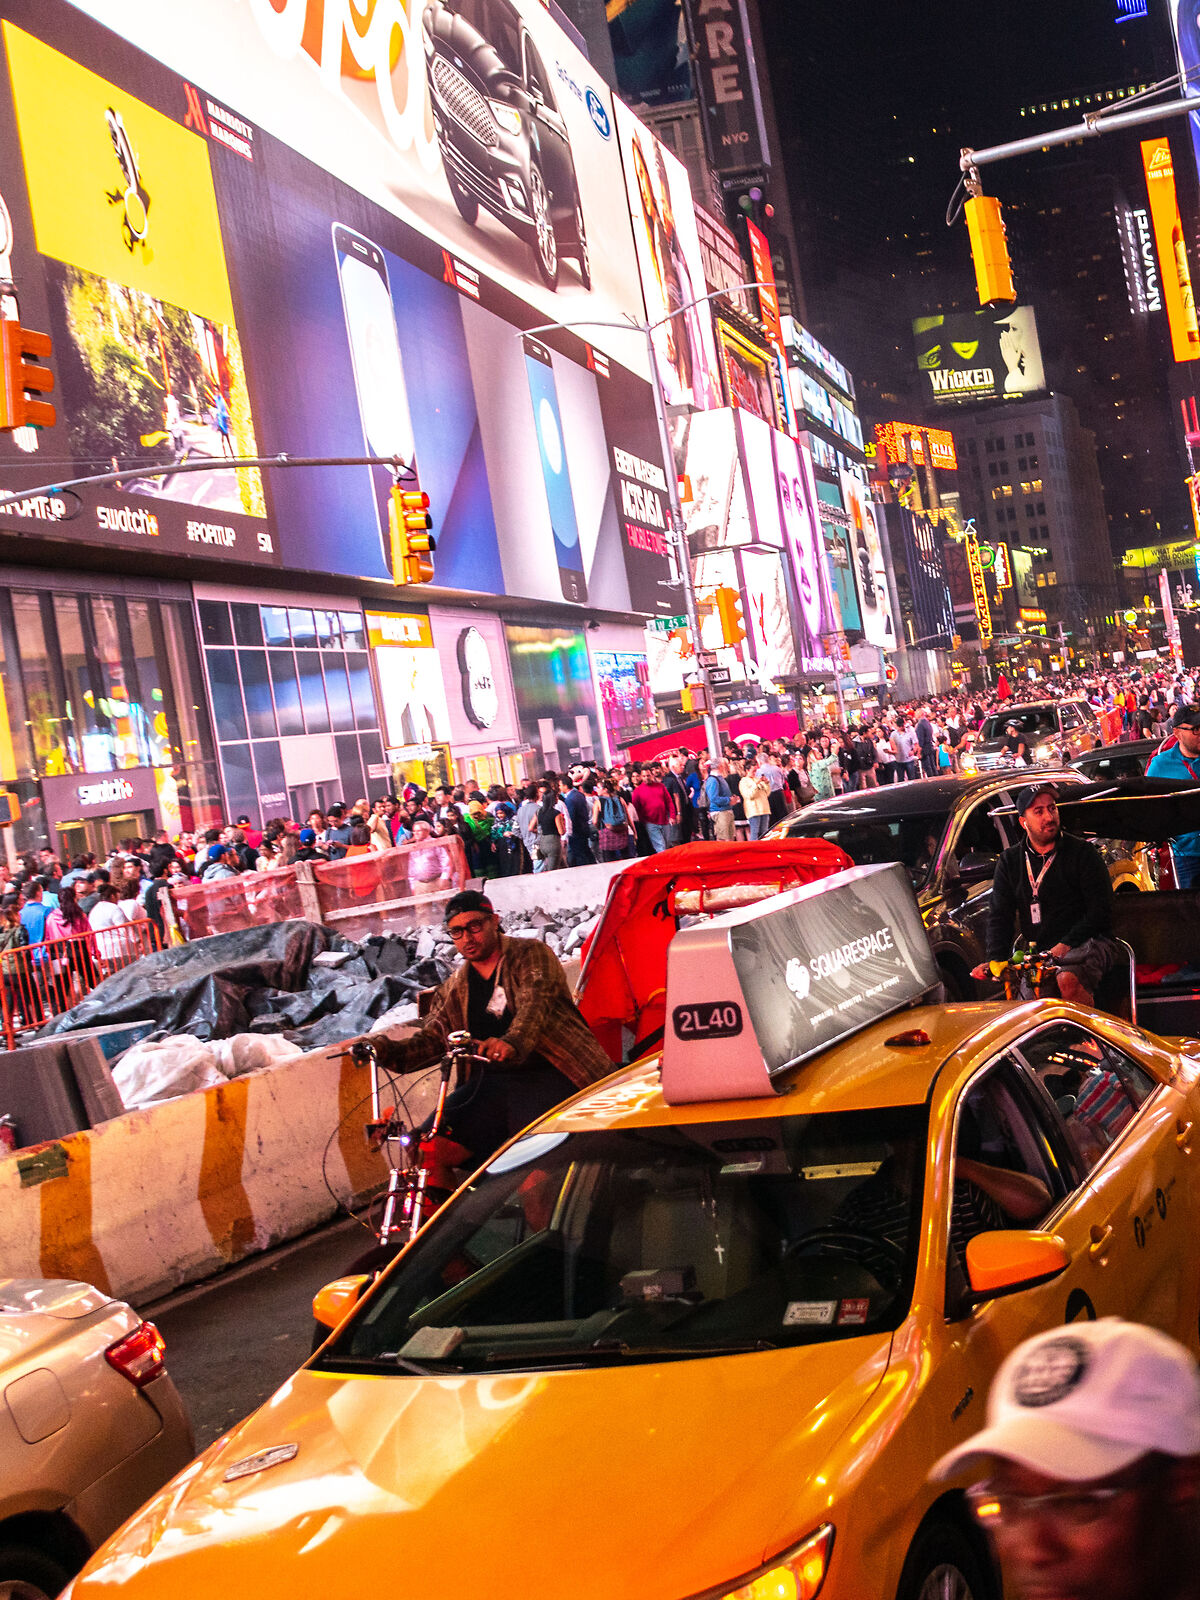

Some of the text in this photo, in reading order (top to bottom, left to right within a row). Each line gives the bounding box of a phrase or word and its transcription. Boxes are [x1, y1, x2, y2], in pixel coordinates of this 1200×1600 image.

[656, 620, 666, 632] W
[668, 617, 679, 630] 45
[711, 671, 726, 680] WAY
[809, 926, 895, 982] SQUARESPACE
[679, 1005, 738, 1033] 2L40
